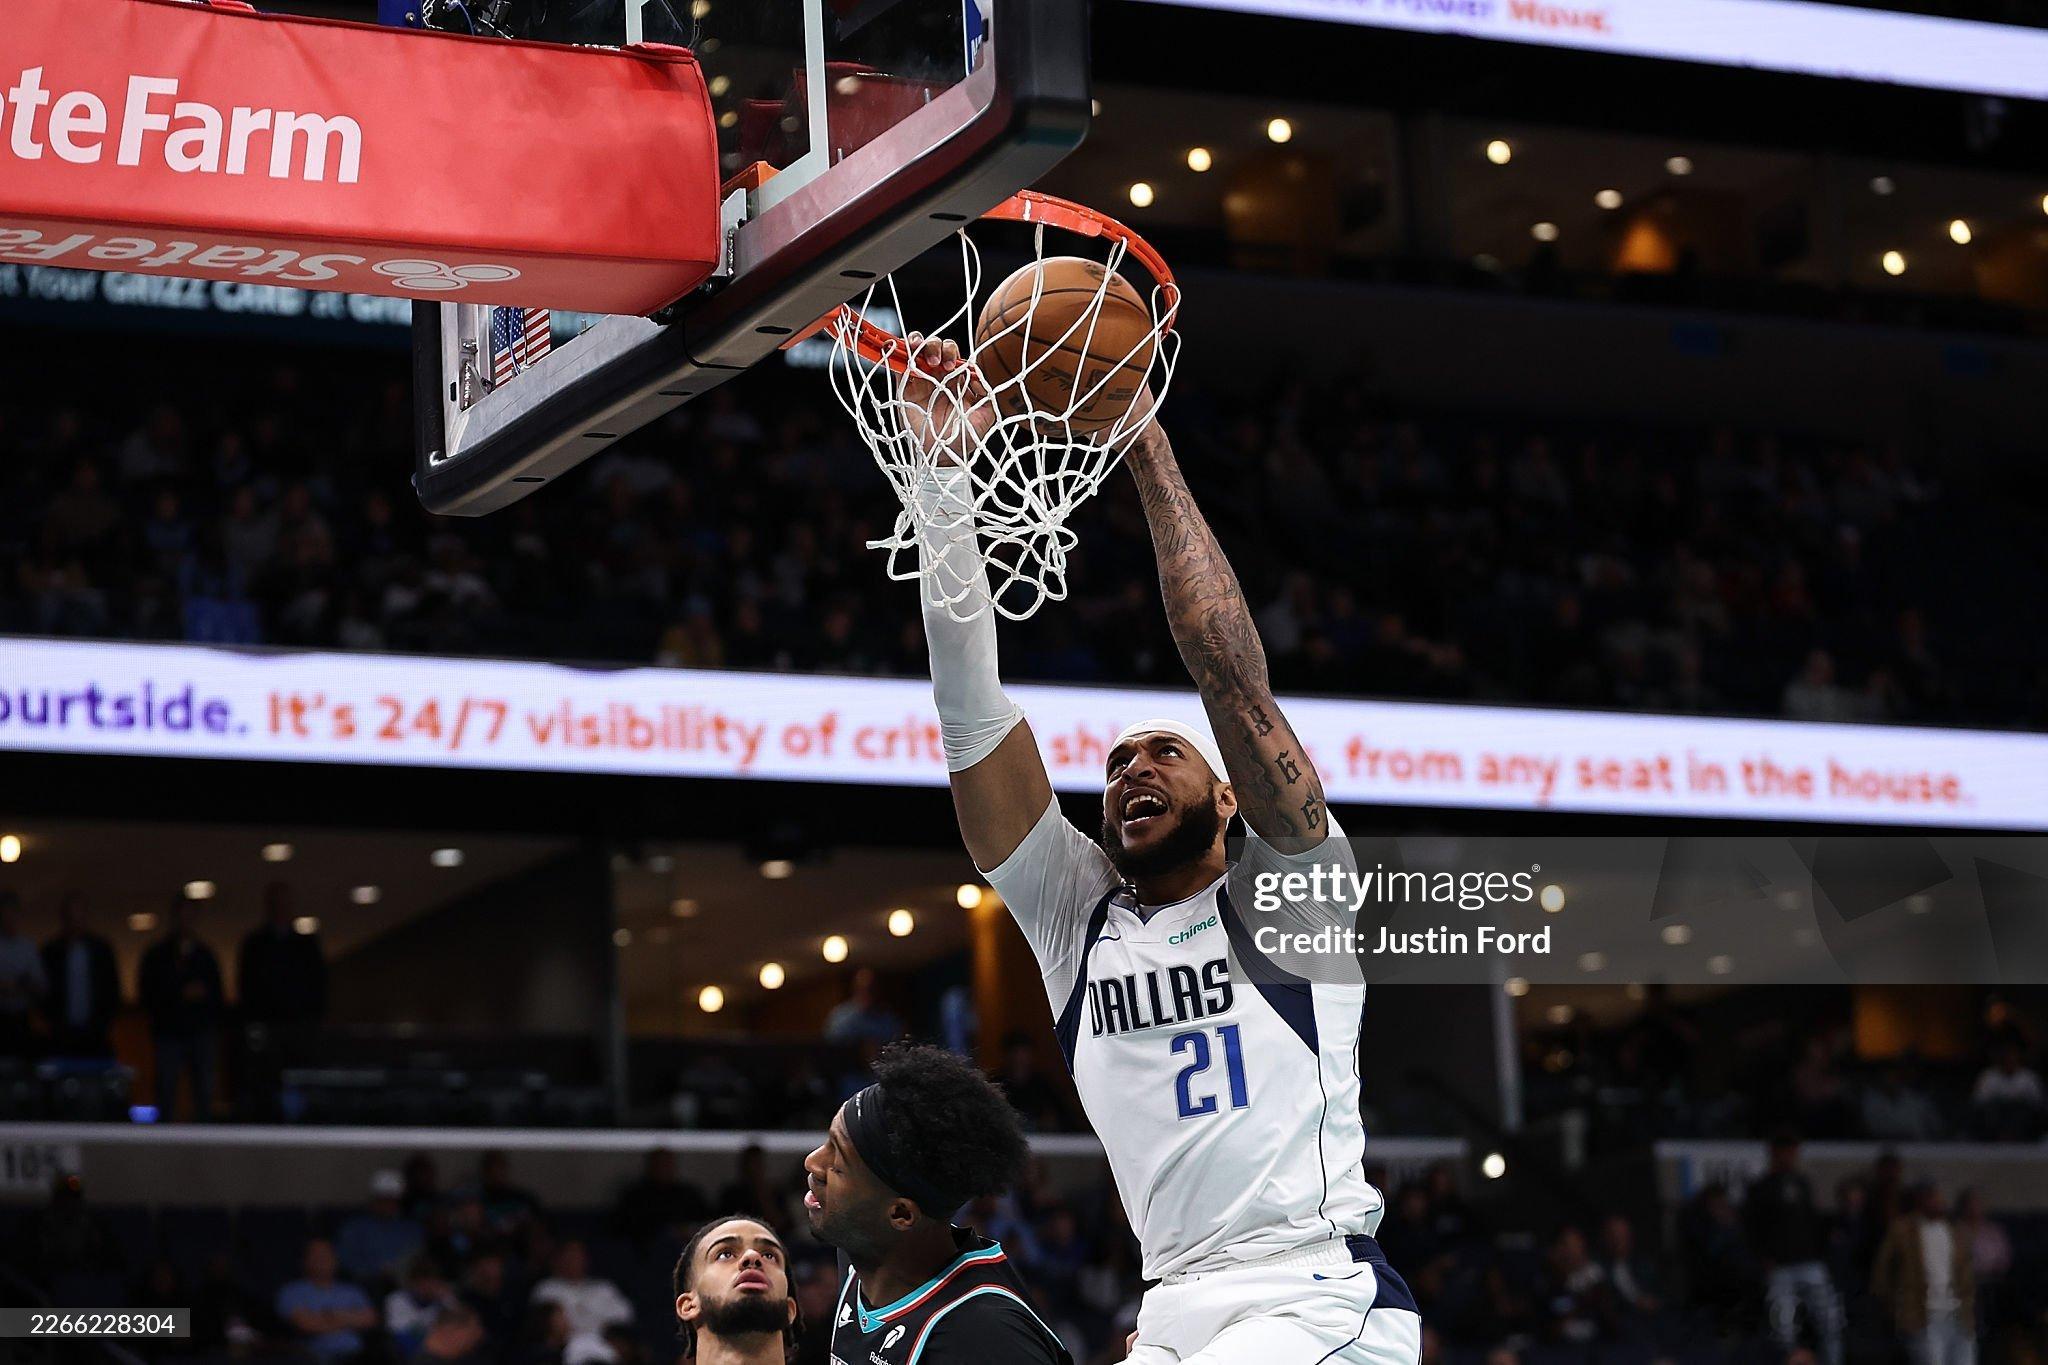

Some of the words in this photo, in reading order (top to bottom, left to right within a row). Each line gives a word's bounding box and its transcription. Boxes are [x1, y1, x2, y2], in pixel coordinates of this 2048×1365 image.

[0, 66, 107, 164] te
[117, 75, 363, 183] Farm
[88, 237, 366, 281] State
[376, 693, 508, 752] 24/7
[526, 698, 764, 774] visibility
[782, 711, 838, 757] of
[853, 714, 944, 764] crit
[1345, 735, 1462, 783] from
[1478, 752, 1560, 807] any
[1576, 752, 1674, 793] seat
[1686, 749, 1728, 794] in
[1740, 755, 1813, 801] the
[1826, 756, 1977, 808] house.
[1168, 915, 1217, 945] chime
[1088, 958, 1235, 1039] DALLAS
[1169, 1022, 1251, 1121] 21
